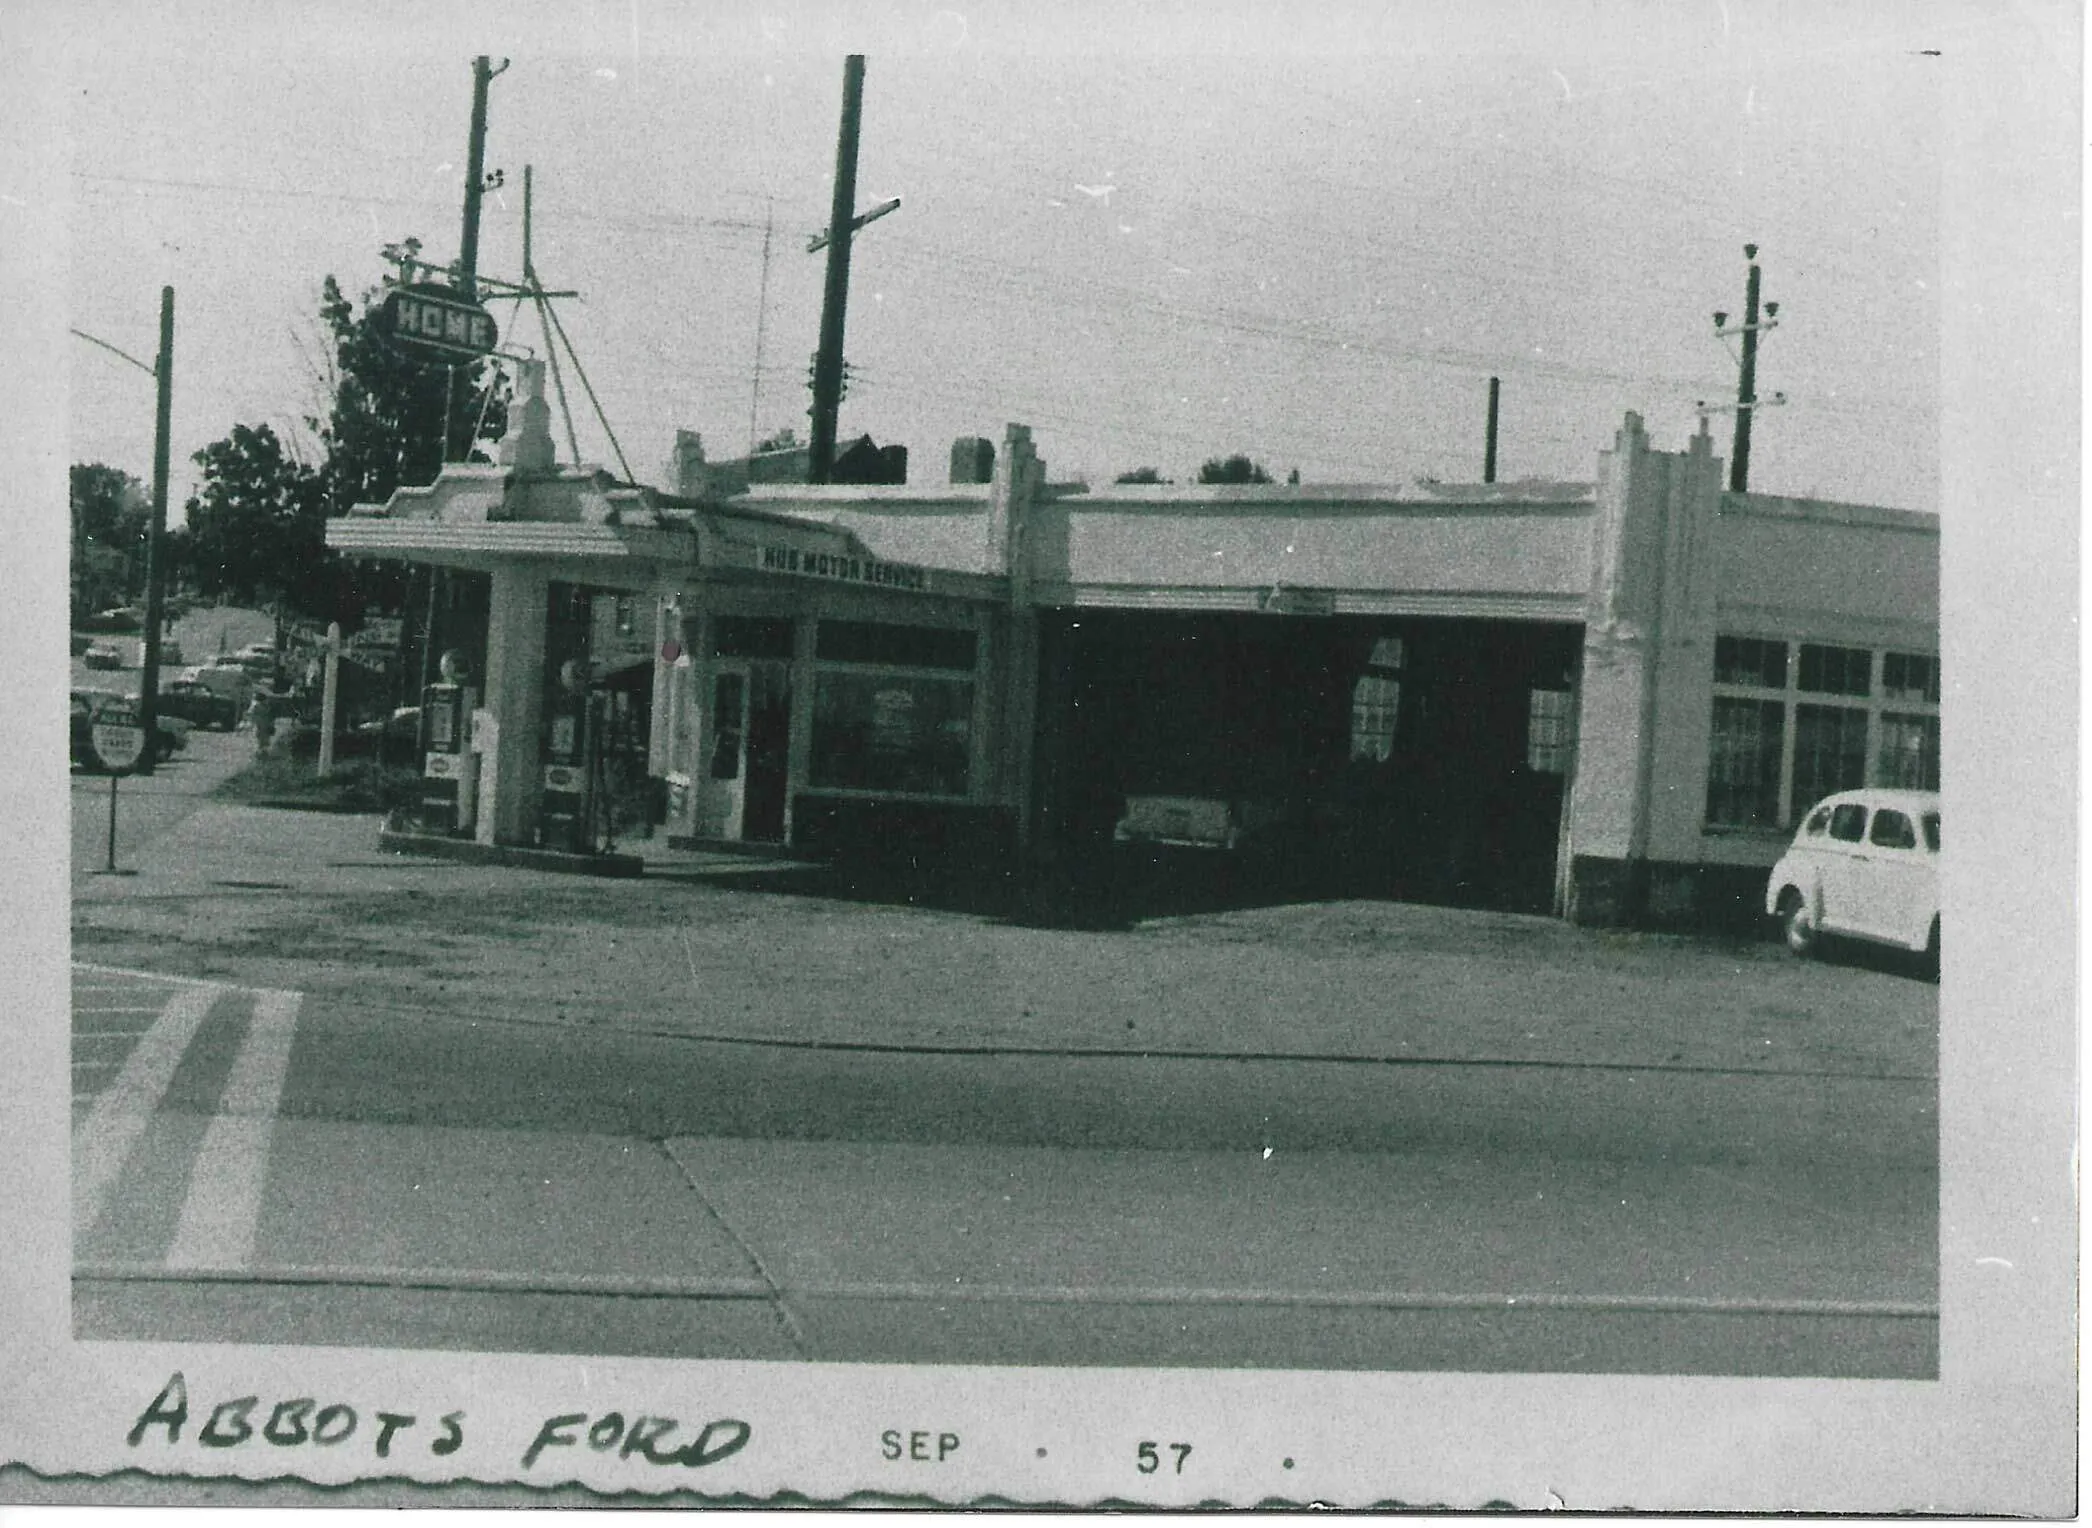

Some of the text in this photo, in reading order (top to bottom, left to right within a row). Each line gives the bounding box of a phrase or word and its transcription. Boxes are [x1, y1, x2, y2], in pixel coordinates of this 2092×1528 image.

[397, 300, 489, 347] HOME
[765, 545, 925, 590] HUB MOTOR SERVICE
[126, 1370, 752, 1469] ABBOTS FORD
